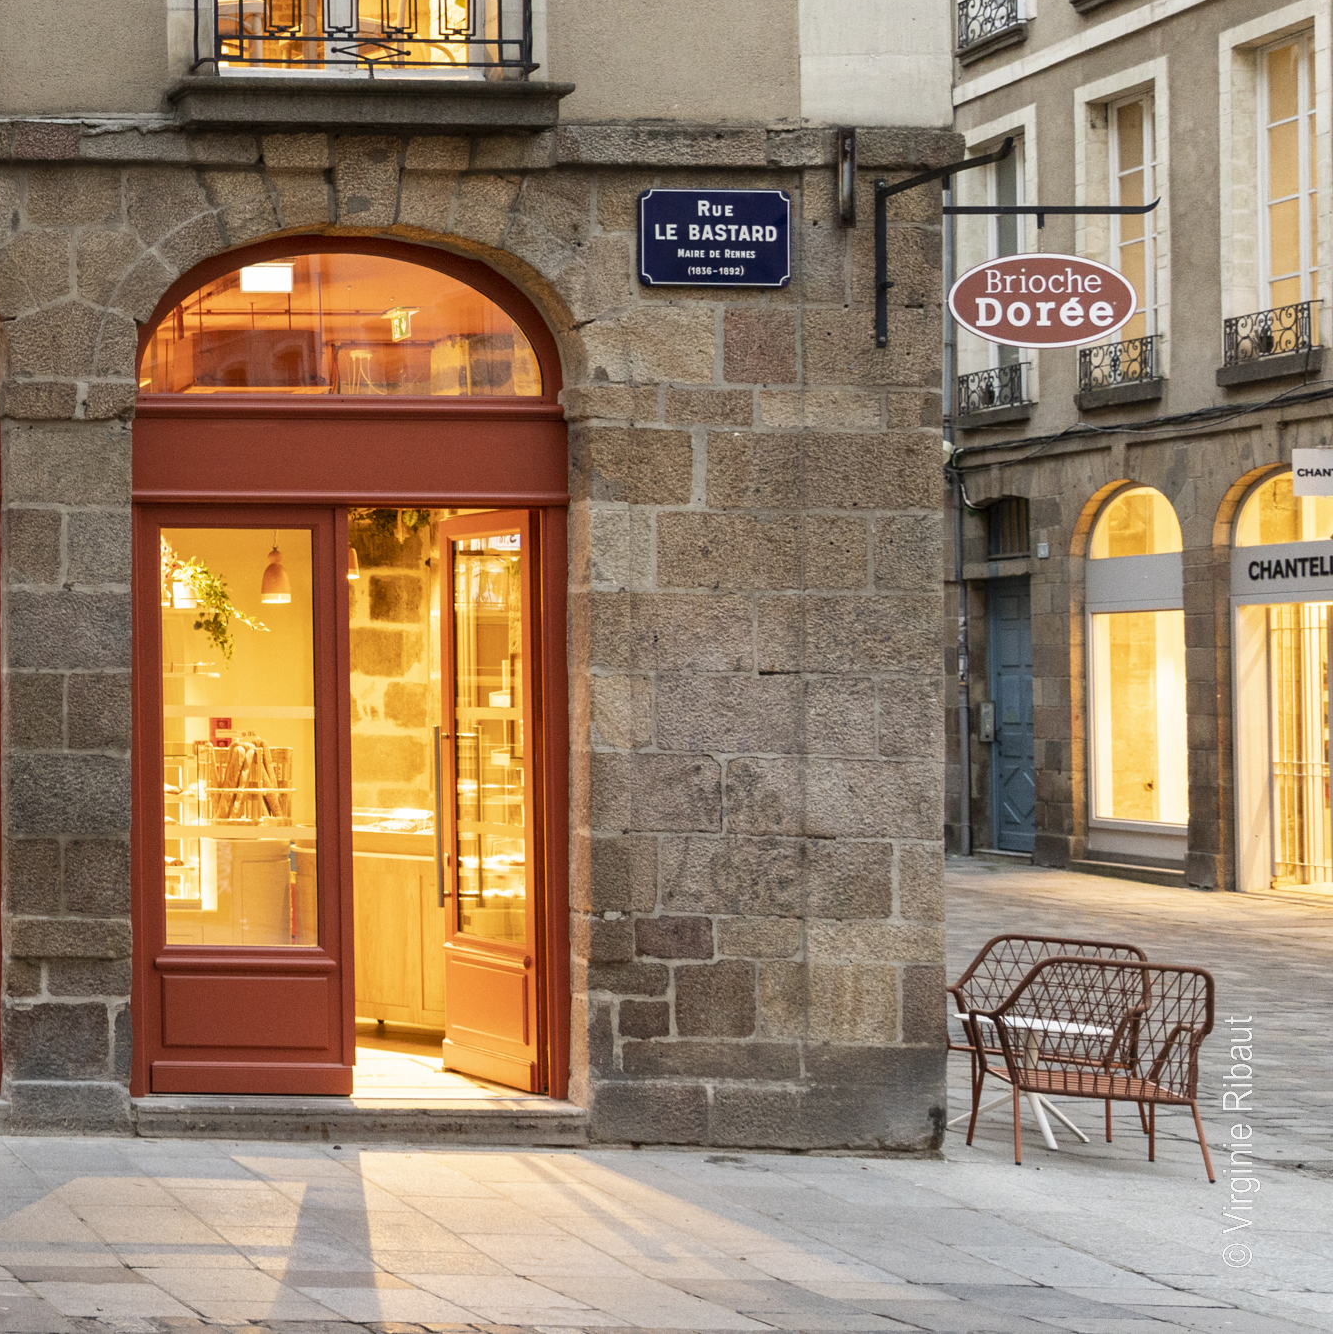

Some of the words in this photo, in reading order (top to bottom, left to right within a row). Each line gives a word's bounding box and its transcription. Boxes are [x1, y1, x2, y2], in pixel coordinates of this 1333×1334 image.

[655, 224, 678, 240] LE
[689, 224, 777, 242] BASTARD
[985, 268, 1102, 294] Brioche
[975, 297, 1115, 327] Dorée
